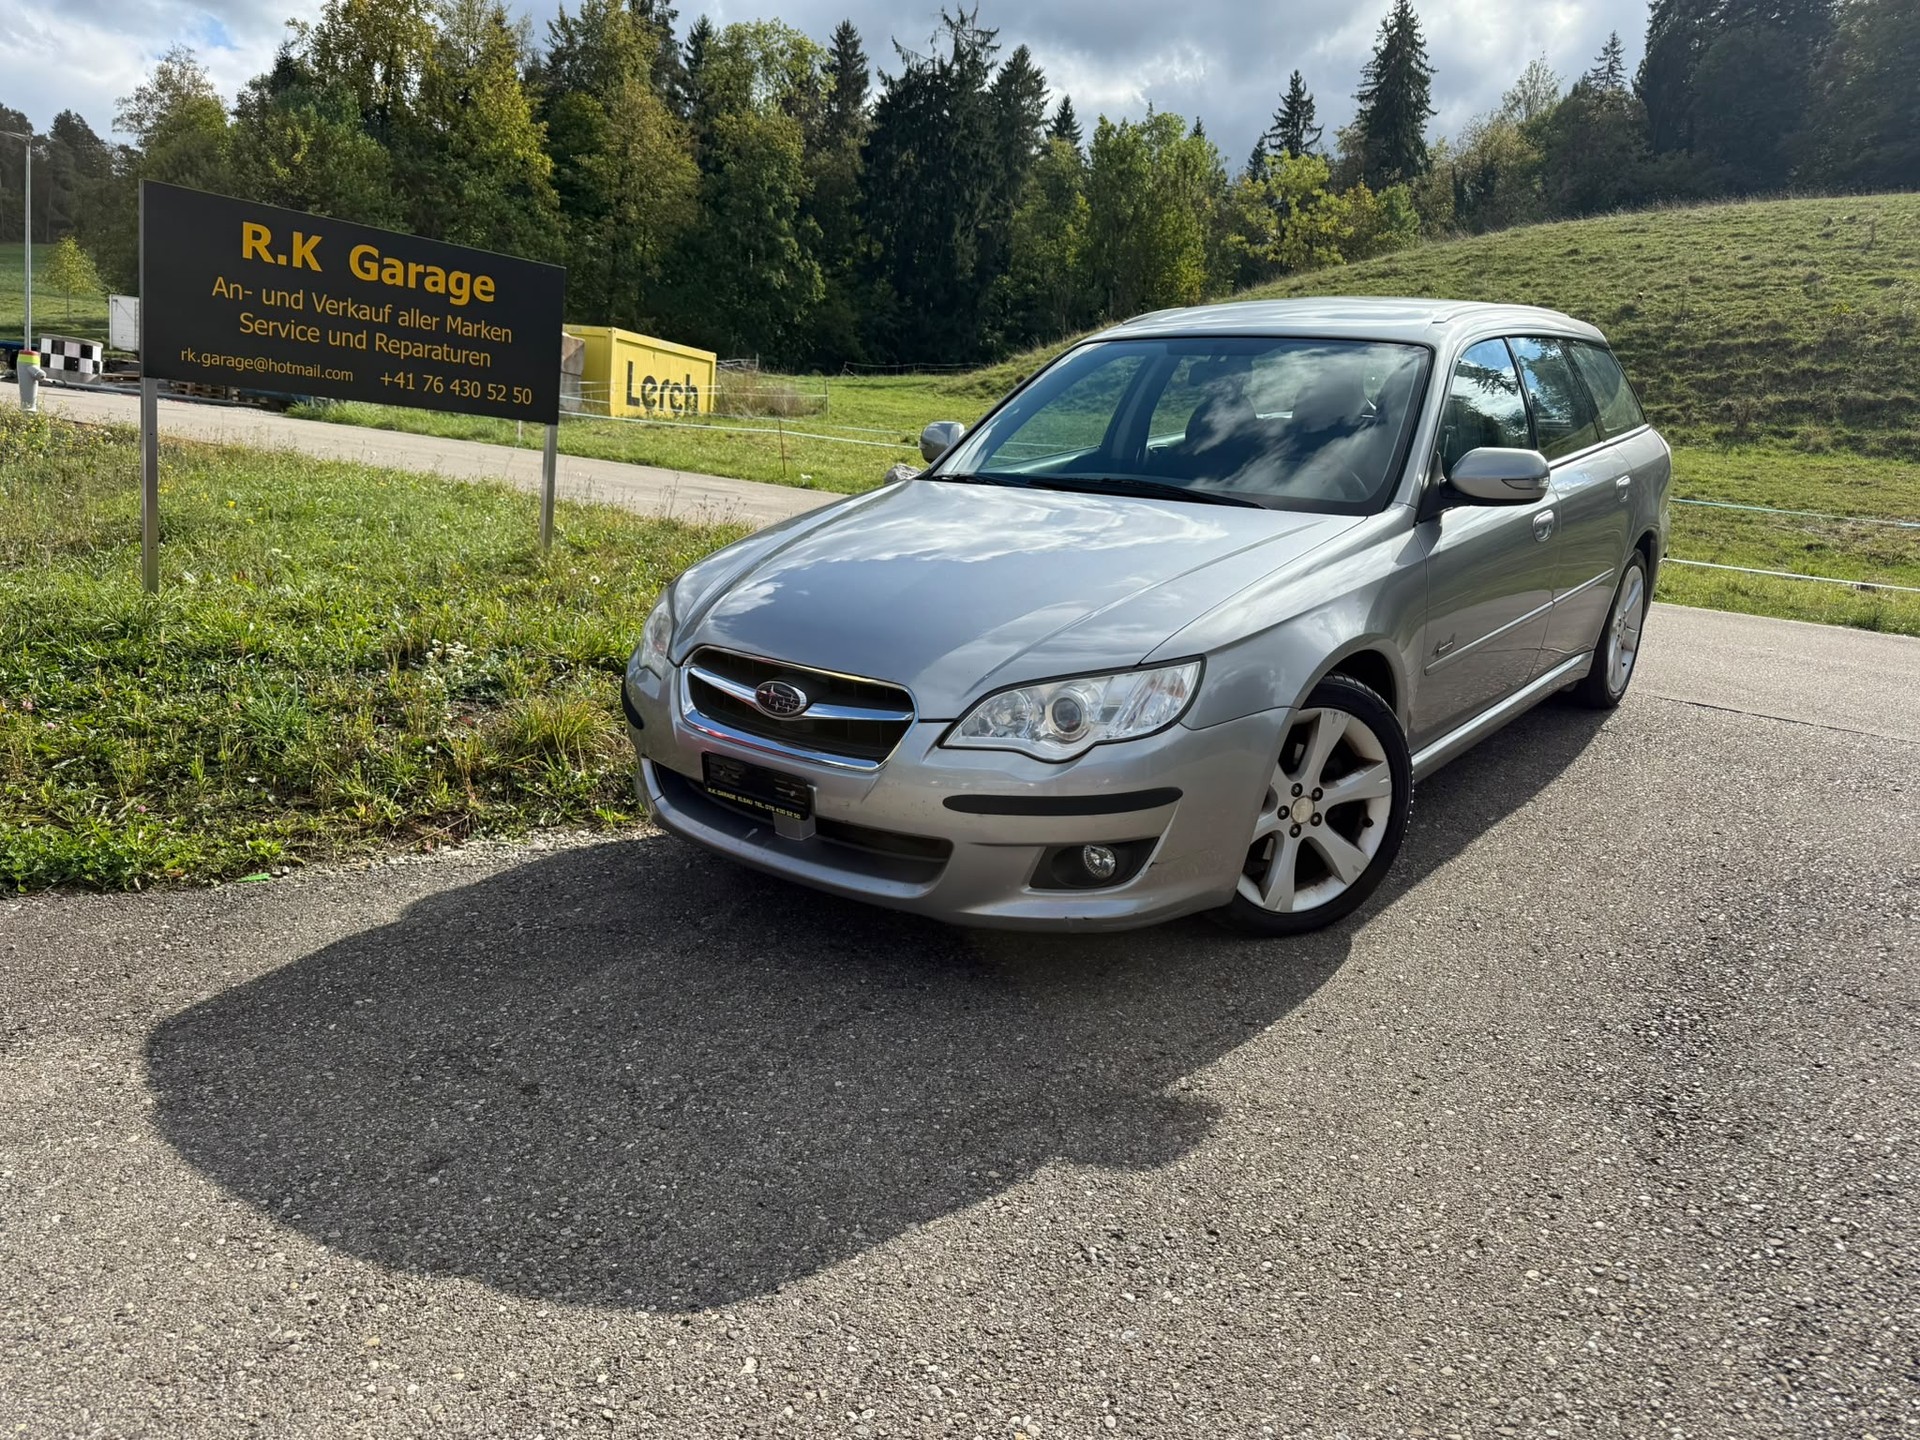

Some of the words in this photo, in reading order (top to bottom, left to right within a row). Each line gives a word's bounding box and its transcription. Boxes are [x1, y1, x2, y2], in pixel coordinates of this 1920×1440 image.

[242, 221, 323, 272] R.K
[349, 244, 496, 306] Garage
[212, 276, 253, 302] An-
[262, 289, 304, 310] und
[313, 292, 392, 326] Verkauf
[398, 309, 441, 332] aller
[446, 315, 512, 345] Marken
[181, 347, 354, 383] rk.garage@hotmail.com
[239, 312, 321, 343] Service
[328, 328, 367, 350] und
[375, 332, 492, 369] Reparaturen
[379, 371, 416, 391] +41
[423, 374, 444, 395] 76
[450, 377, 481, 400] 430
[487, 382, 507, 403] 52
[512, 386, 532, 407] 50
[626, 360, 699, 416] Lerch
